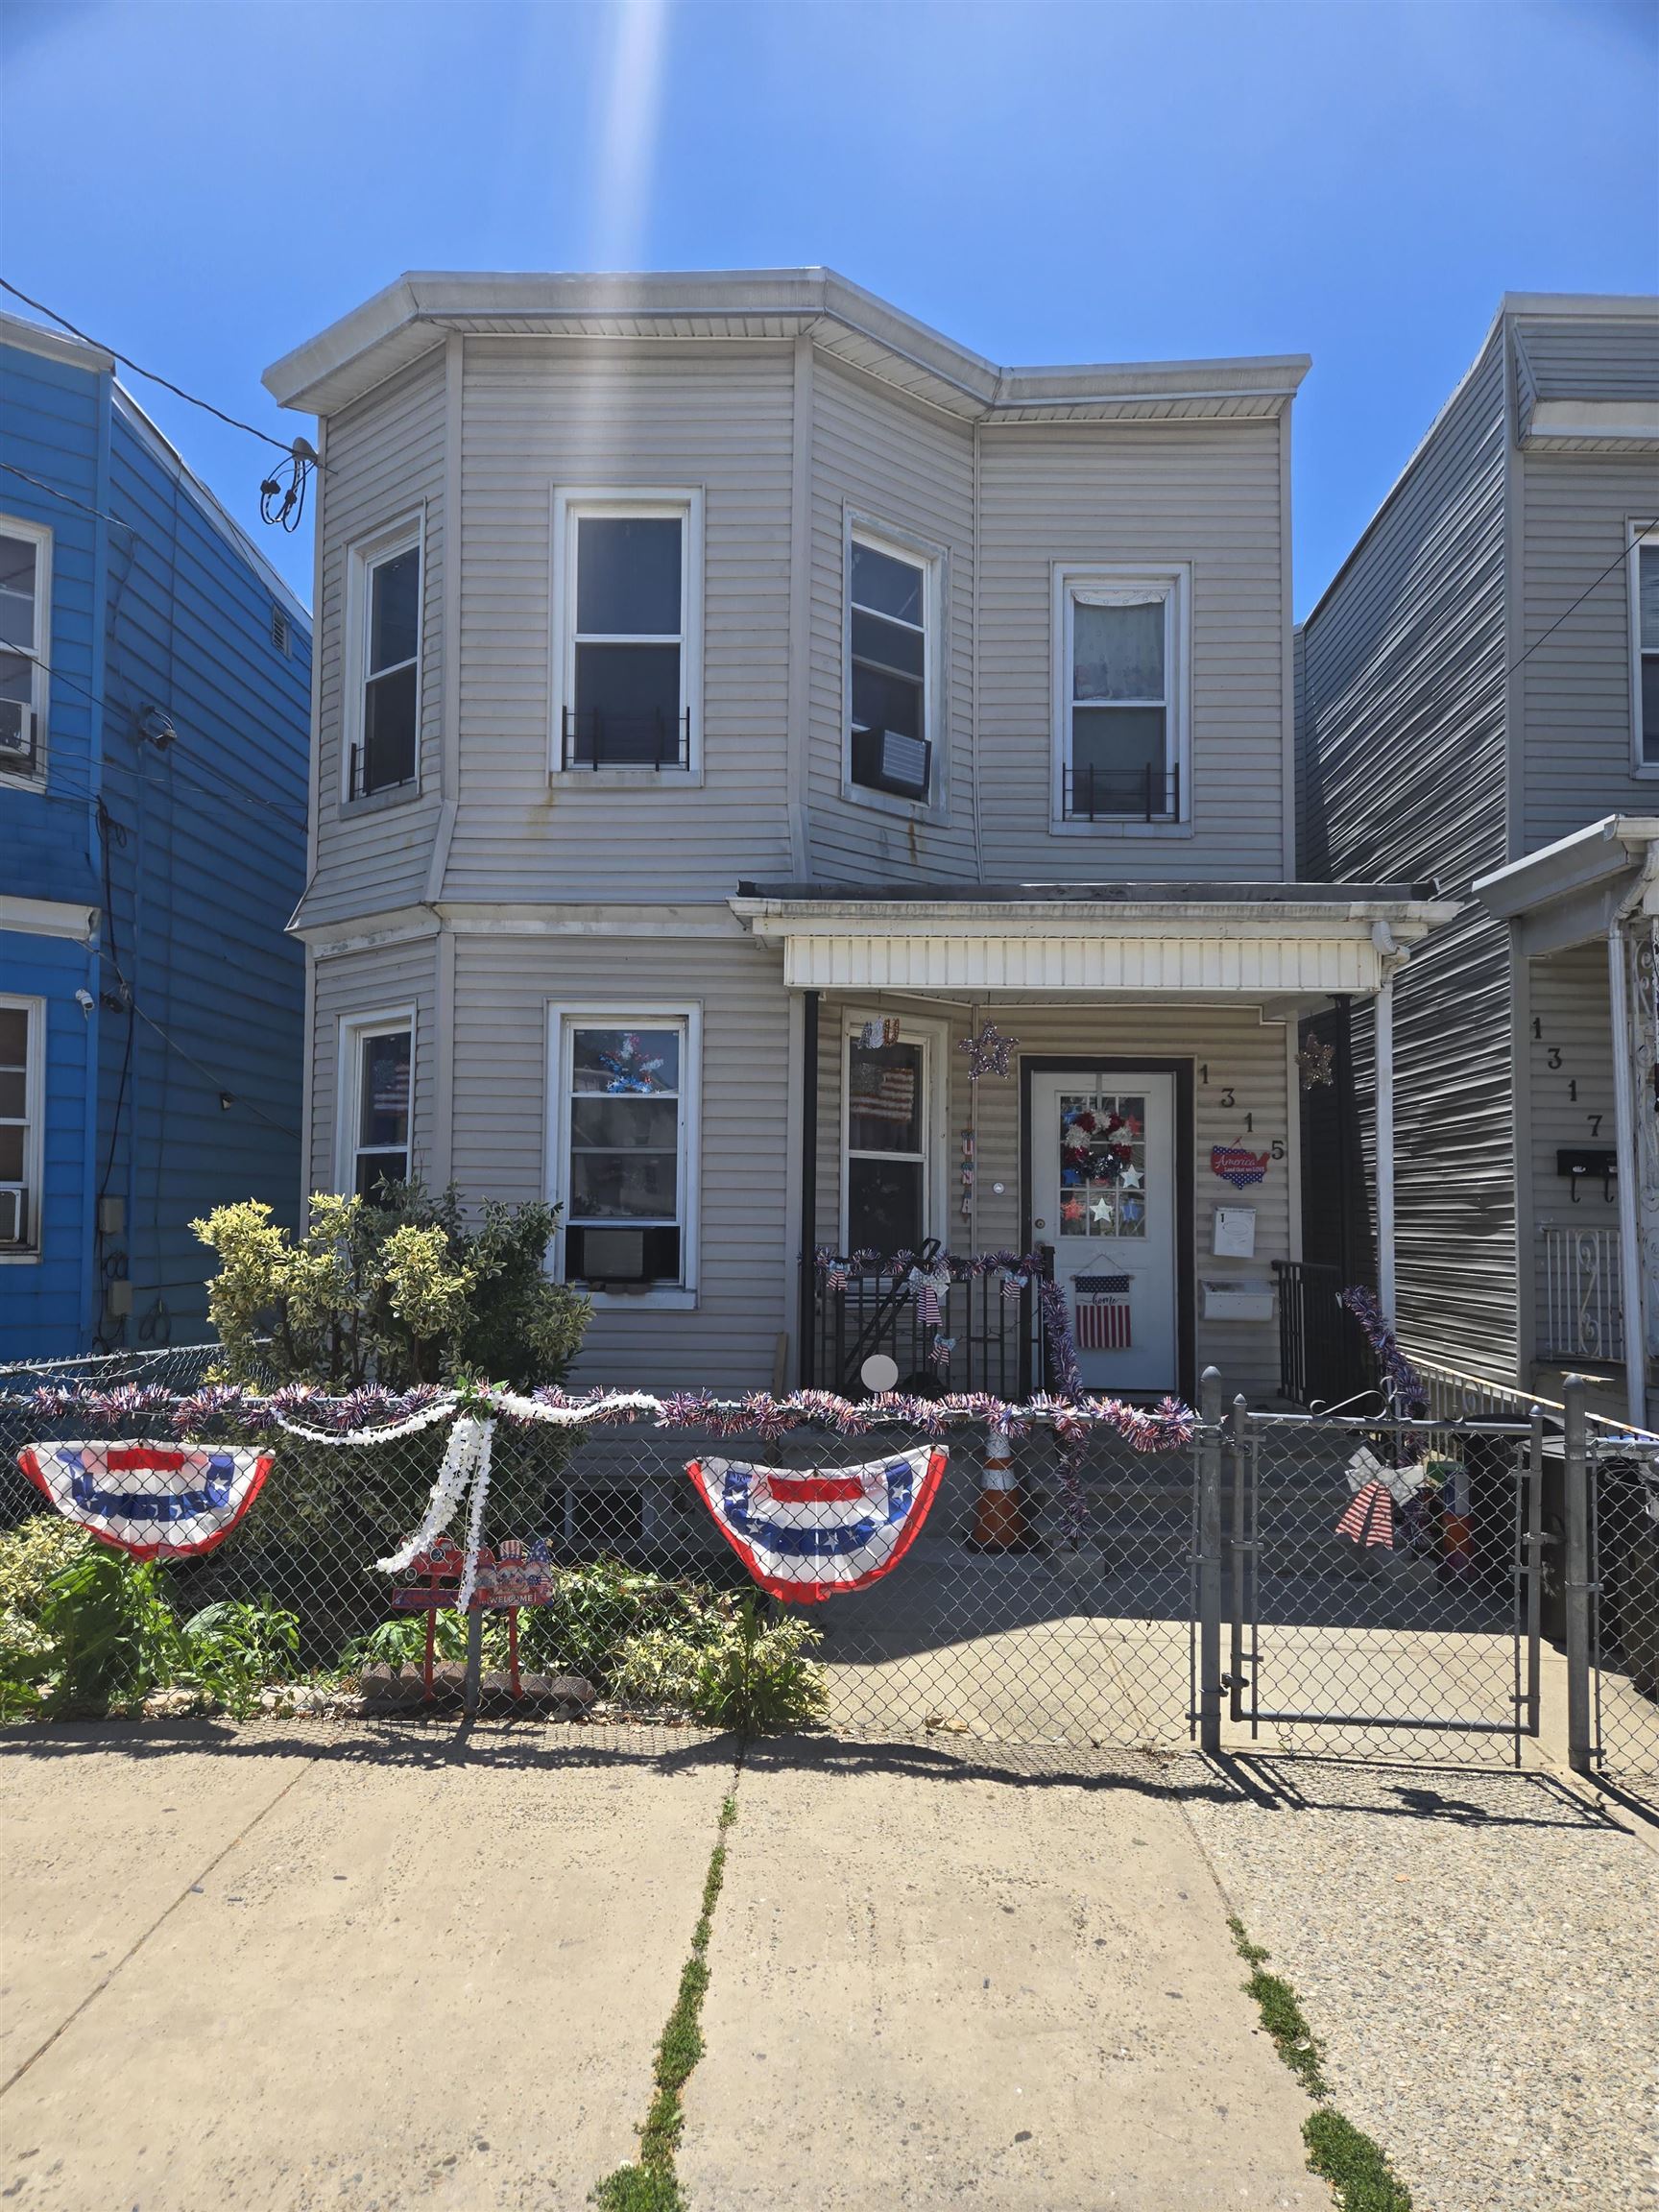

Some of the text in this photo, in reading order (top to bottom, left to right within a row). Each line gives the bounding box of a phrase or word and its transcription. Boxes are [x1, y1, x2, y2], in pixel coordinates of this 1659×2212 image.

[1214, 1154, 1256, 1168] America
[1092, 1291, 1116, 1306] home
[490, 1594, 533, 1603] WELCOME
